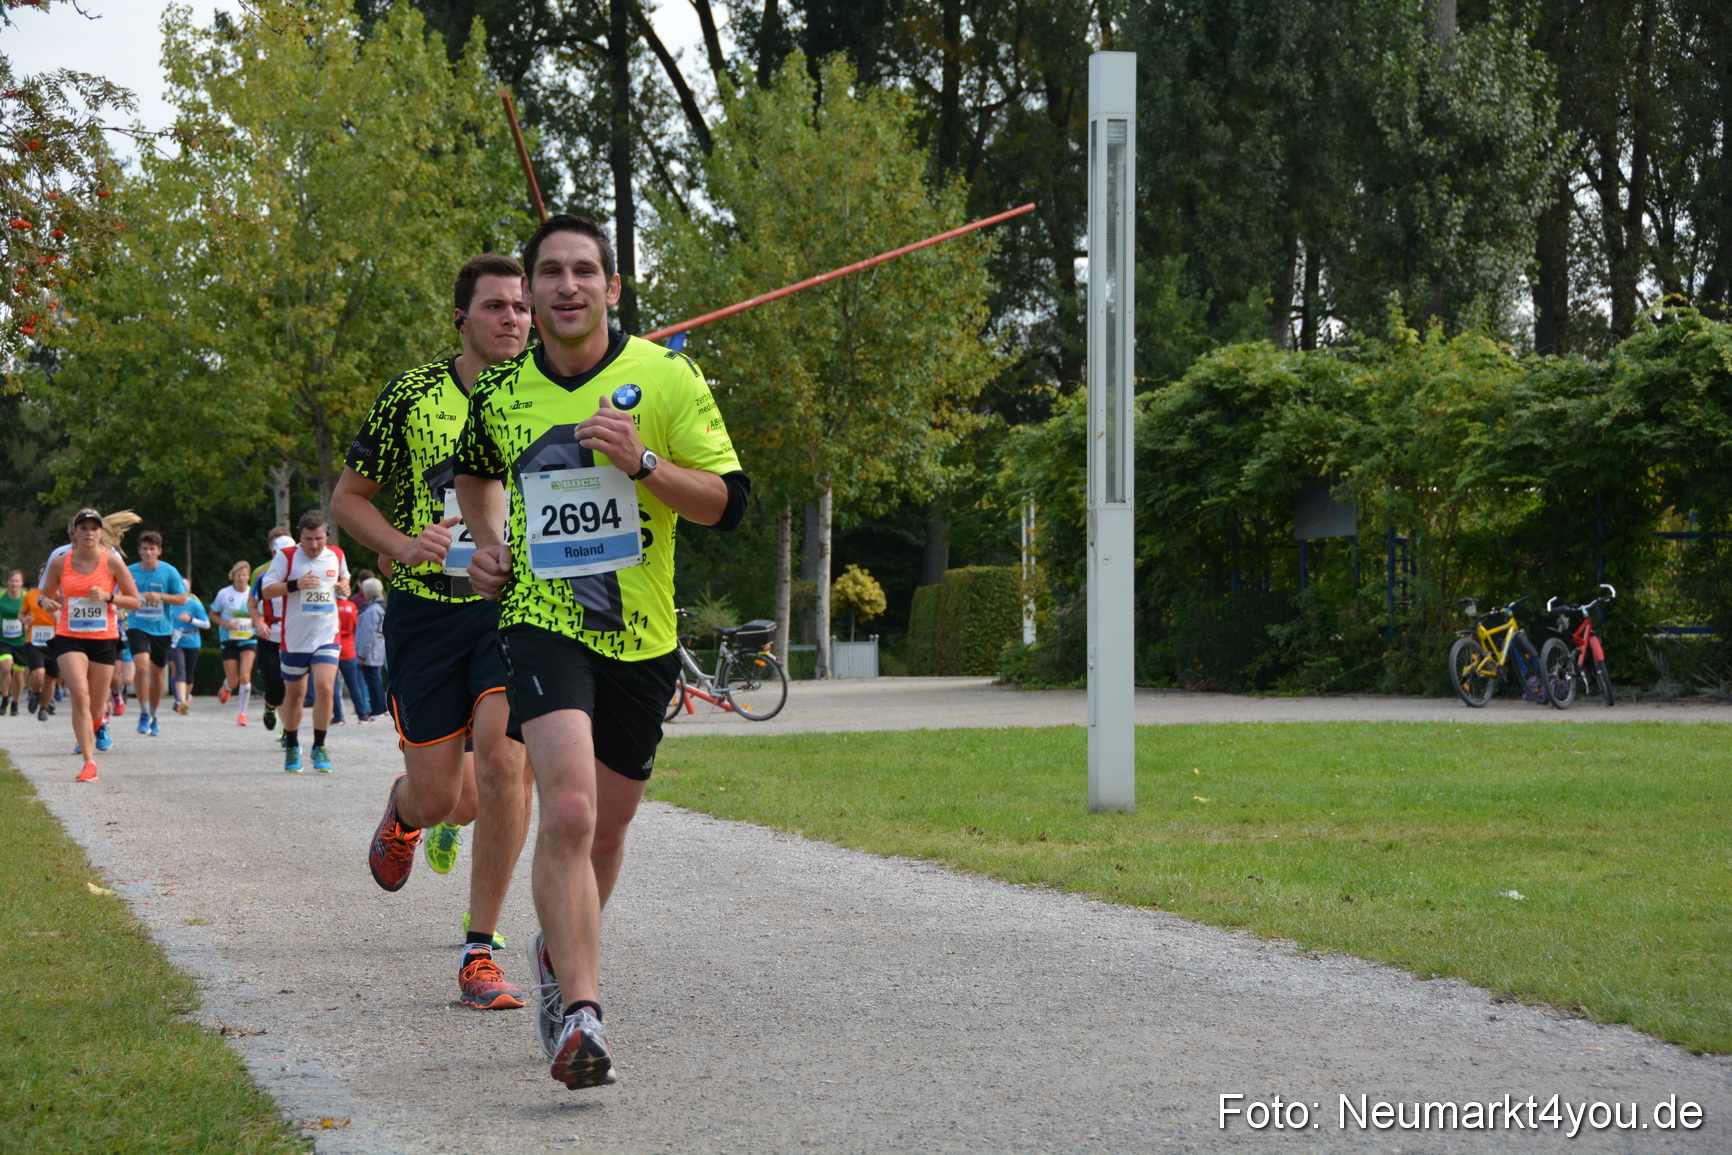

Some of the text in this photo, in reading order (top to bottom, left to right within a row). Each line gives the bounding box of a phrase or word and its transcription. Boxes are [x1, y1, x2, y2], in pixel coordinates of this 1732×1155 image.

[562, 477, 600, 489] BOCK
[541, 498, 622, 537] 2694
[564, 543, 604, 558] Roland
[306, 591, 331, 602] 2362
[73, 607, 102, 618] 2159
